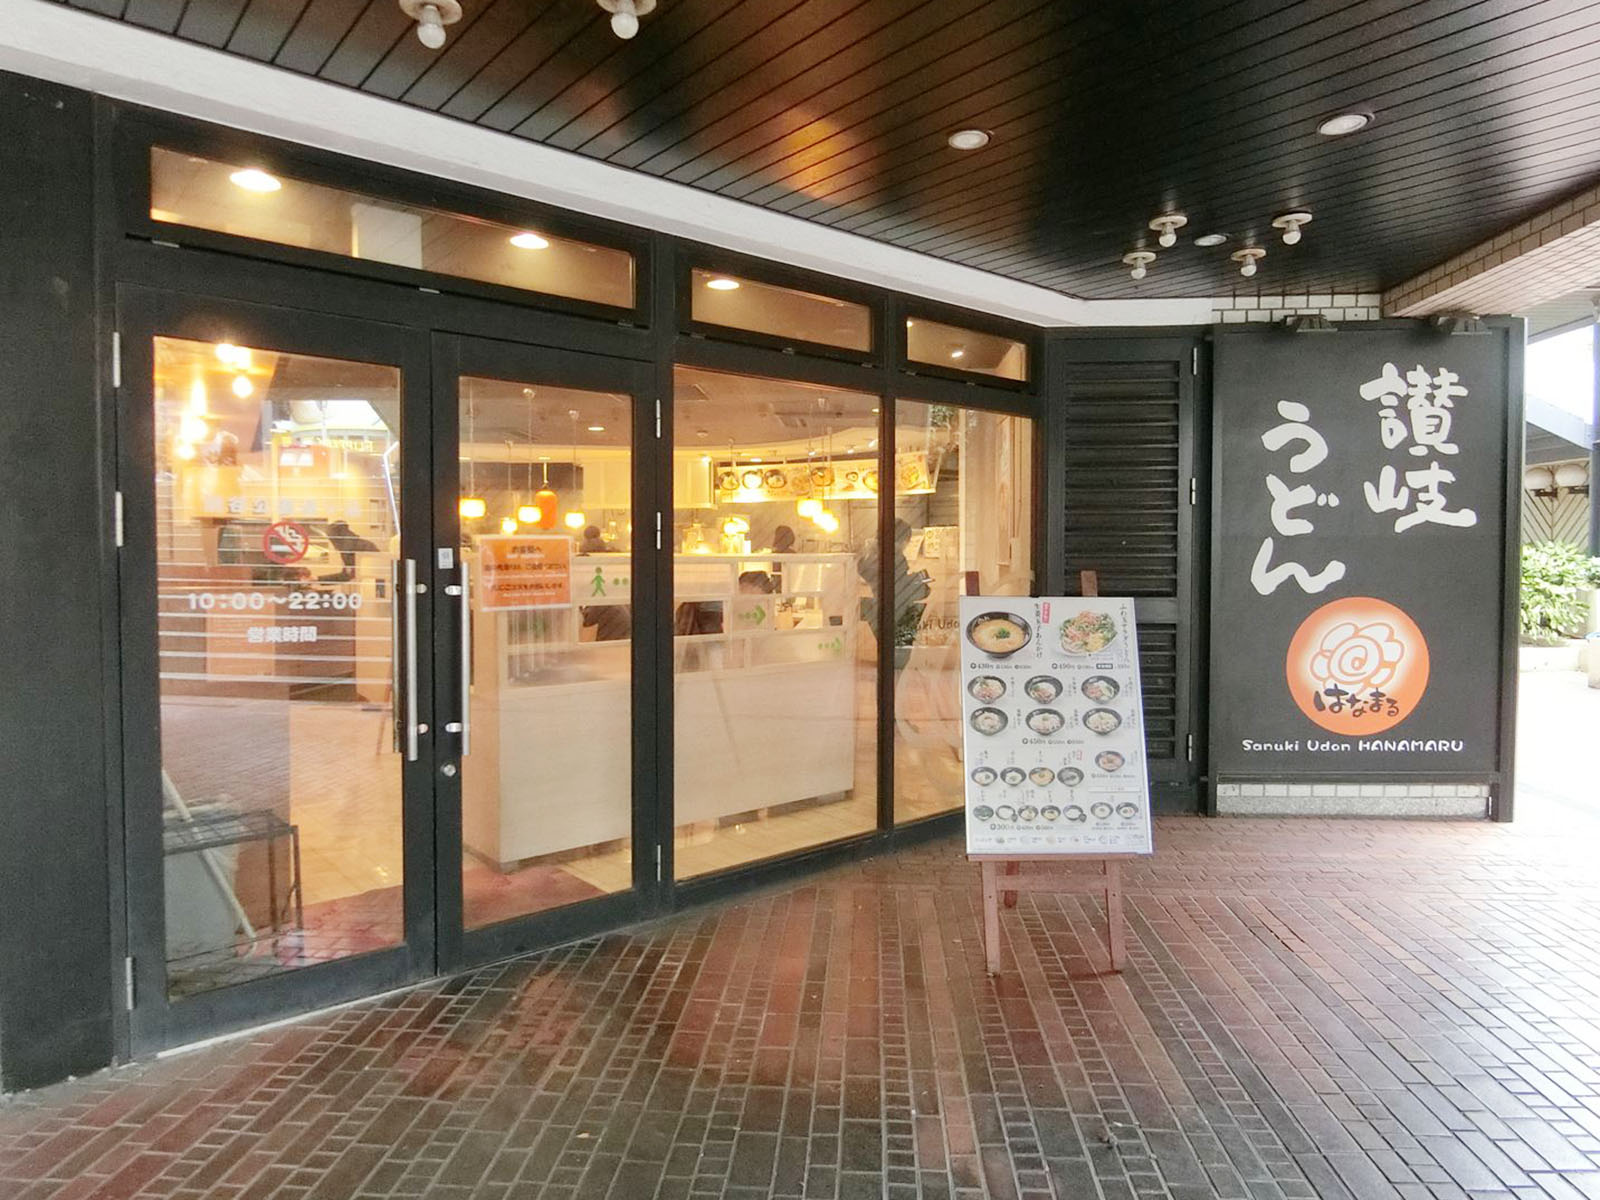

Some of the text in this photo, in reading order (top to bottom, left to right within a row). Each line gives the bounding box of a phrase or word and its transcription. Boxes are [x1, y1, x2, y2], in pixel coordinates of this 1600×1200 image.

[1359, 362, 1478, 533] 讃岐
[1250, 400, 1346, 595] うどん
[246, 626, 318, 643] 営業時間
[1313, 683, 1400, 718] はなまる
[1241, 739, 1464, 752] Sanuki Udon HANAMARU
